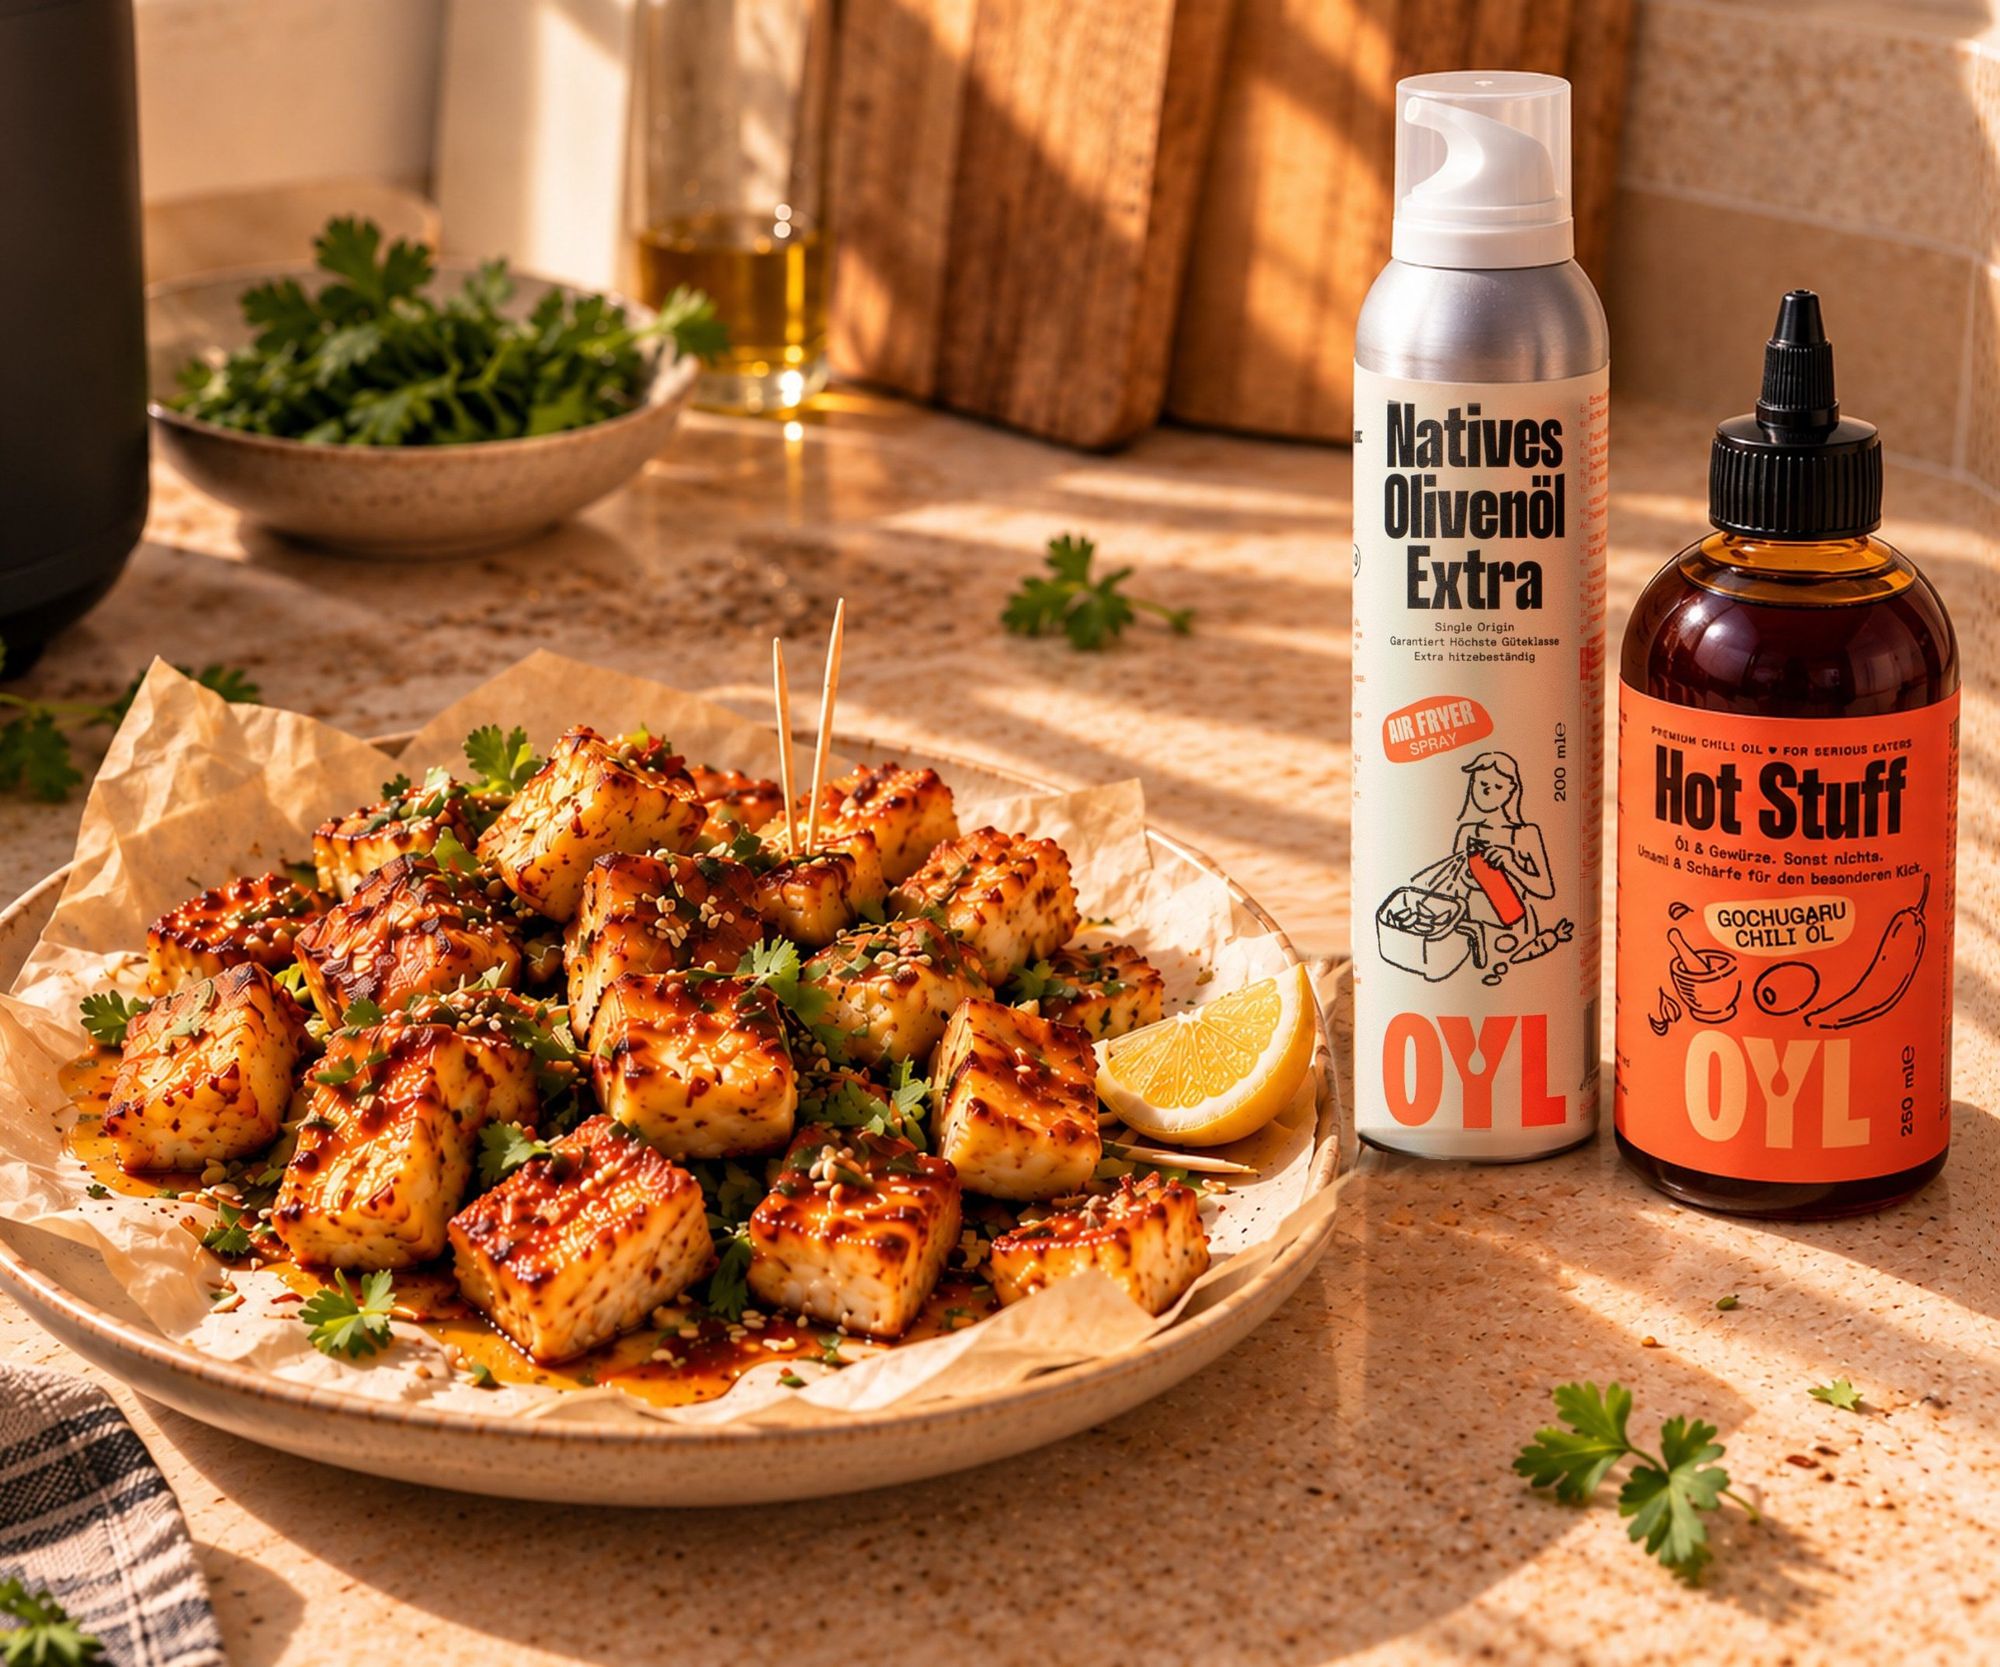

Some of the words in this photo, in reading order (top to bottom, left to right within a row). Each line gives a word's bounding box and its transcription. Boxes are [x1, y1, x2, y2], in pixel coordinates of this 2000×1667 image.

[1387, 400, 1563, 468] Natives
[1384, 473, 1565, 539] Olivenöl
[1407, 545, 1542, 610] Extra
[1389, 635, 1445, 647] Garantiert
[1450, 637, 1497, 647] Höchste
[1502, 636, 1560, 647] Güteklasse
[1435, 622, 1472, 634] Single
[1477, 622, 1515, 634] Origin
[1414, 652, 1443, 662] Extra
[1448, 652, 1536, 664] hitzebeständig
[1387, 715, 1415, 745] AIR
[1415, 700, 1476, 737] FRYER
[1409, 732, 1457, 756] SPRAY
[1651, 725, 1696, 745] PREMIUM
[1741, 743, 1763, 755] OIL
[1783, 746, 1808, 757] FOR
[1814, 744, 1867, 757] SERIOUS
[1873, 738, 1912, 753] EATERS
[1554, 767, 1566, 802] 200
[1656, 744, 1742, 835] Hot
[1759, 756, 1907, 840] Stuff
[1694, 842, 1704, 855] &
[1709, 844, 1776, 864] Gewürze.
[1784, 852, 1828, 866] Sonst
[1834, 850, 1884, 865] nichts.
[1673, 857, 1682, 869] &
[1777, 871, 1805, 885] den
[1811, 869, 1892, 885] besonderen
[1717, 901, 1846, 928] GOCHUGARU
[1735, 927, 1797, 948] CHILI
[1382, 1012, 1566, 1129] OYL
[1685, 1030, 1870, 1149] OYL
[1901, 1096, 1913, 1137] 250
